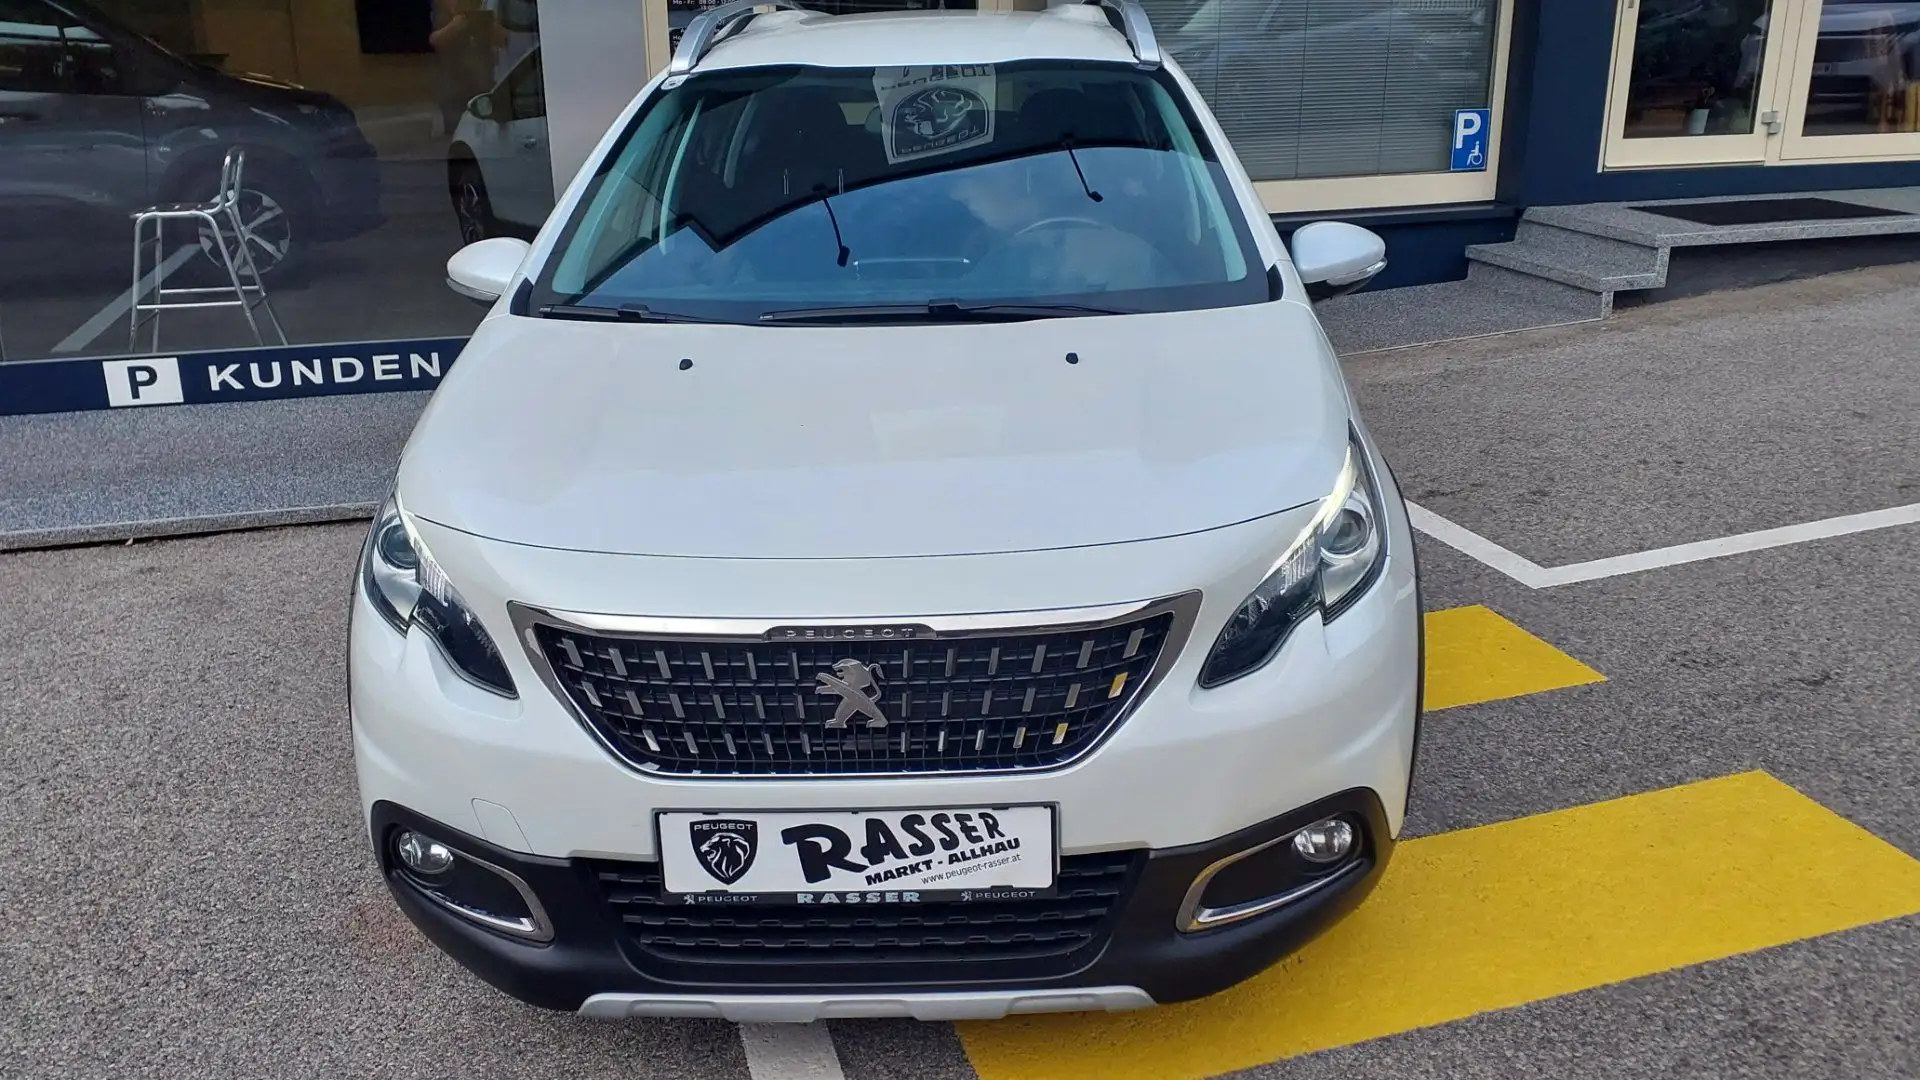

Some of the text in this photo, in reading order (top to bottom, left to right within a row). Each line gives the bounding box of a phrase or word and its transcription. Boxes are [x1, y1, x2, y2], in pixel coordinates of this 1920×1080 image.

[1455, 112, 1481, 149] P
[126, 352, 441, 400] P KUNDEN
[784, 628, 914, 640] PEUGEOT
[693, 822, 753, 831] PEUGEOT
[781, 812, 1006, 884] RASSER
[865, 859, 933, 886] MARKT
[948, 837, 1021, 865] ALLHAU
[920, 853, 1022, 885] www.peugeot-rasser.at
[698, 895, 758, 903] PEUGEOT
[796, 892, 921, 904] RASSER
[975, 891, 1037, 900] PEUGEOT
